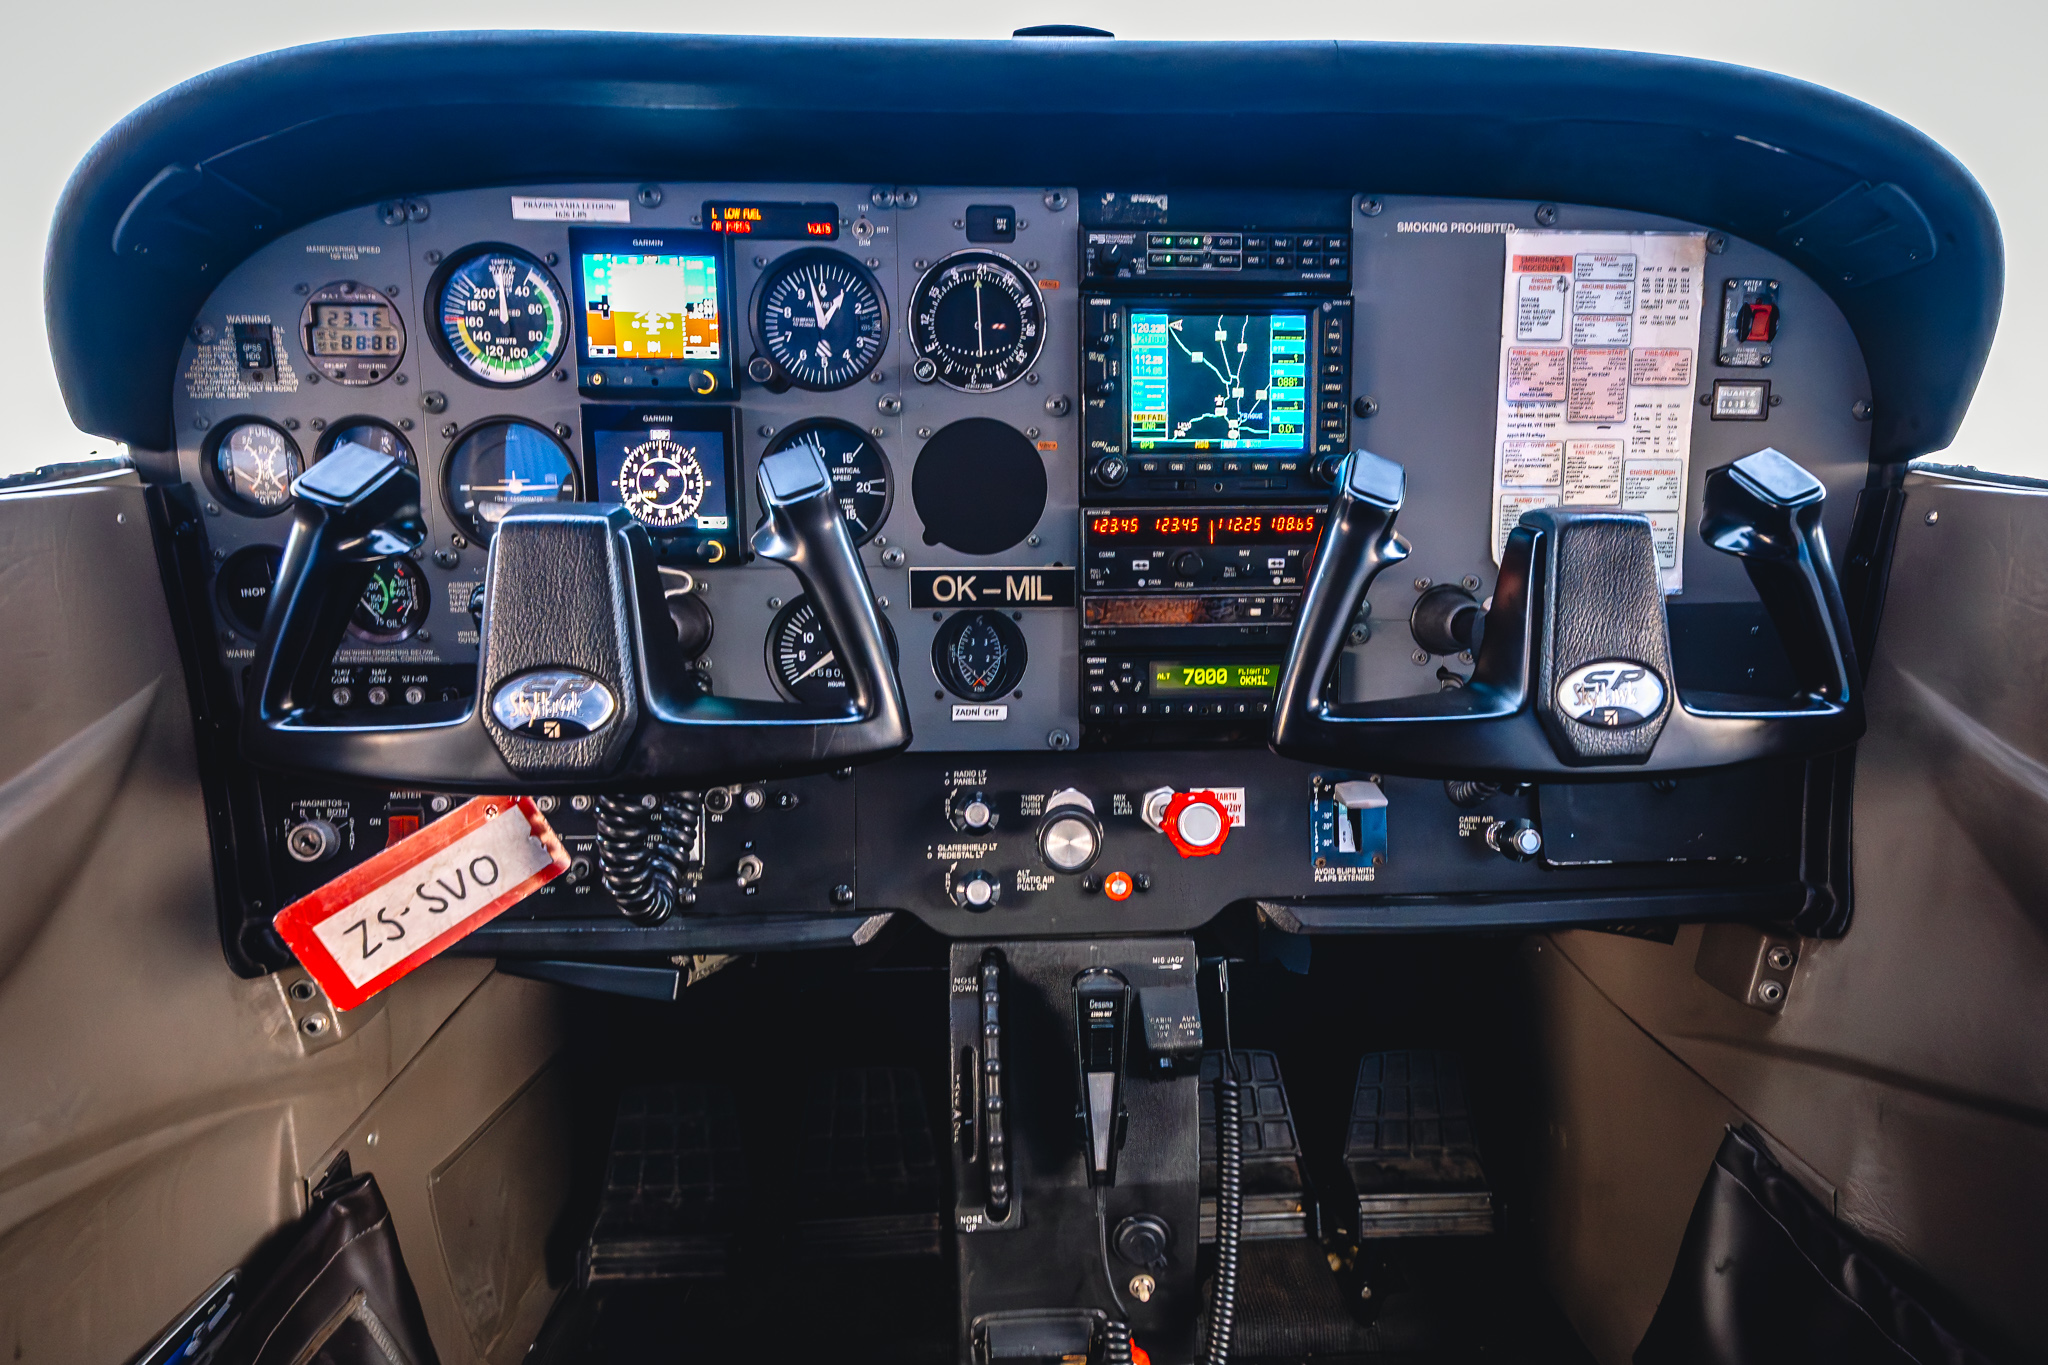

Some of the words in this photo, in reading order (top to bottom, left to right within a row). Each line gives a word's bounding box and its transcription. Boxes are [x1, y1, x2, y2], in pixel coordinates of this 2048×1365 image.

[724, 207, 740, 220] LOW
[743, 208, 761, 220] FUEL
[807, 222, 832, 235] VOLTS
[1397, 222, 1448, 233] SMOKING
[1451, 222, 1516, 234] PROHIBITED
[632, 239, 664, 247] GARMIN
[977, 264, 988, 275] 21
[473, 288, 496, 300] 200
[515, 286, 530, 298] 40
[467, 300, 486, 312] 180
[528, 304, 543, 315] 60
[226, 314, 271, 324] WARNING
[465, 316, 484, 328] 160
[473, 331, 491, 342] 140
[528, 330, 543, 341] 80
[785, 331, 792, 343] 7
[485, 345, 504, 357] 120
[510, 347, 528, 358] 100
[642, 414, 673, 423] GARMIN
[842, 452, 854, 464] 15
[832, 467, 861, 475] VERTICAL
[856, 481, 871, 493] 20
[1093, 517, 1139, 533] 123.45
[1155, 517, 1199, 532] 123.45
[1218, 517, 1261, 531] 112.25
[1239, 549, 1251, 557] NAV
[240, 587, 266, 598] INOP
[386, 619, 401, 628] OIL
[803, 631, 815, 643] 10
[1183, 668, 1228, 686] 7000
[1240, 676, 1268, 685] OKMIL
[955, 705, 980, 717] ZADNÍ
[984, 709, 1000, 717] CHT
[1095, 706, 1100, 714] 0
[1188, 705, 1193, 713] 4
[1262, 704, 1268, 712] 7
[954, 770, 977, 778] RADIO
[978, 769, 987, 778] LT
[953, 777, 978, 786] PANEL
[978, 777, 987, 785] LT
[389, 791, 422, 800] MASTER
[1020, 794, 1046, 802] THROT
[1113, 793, 1127, 801] MIX
[300, 799, 342, 808] MAGNETOS
[1020, 801, 1041, 809] PUSH
[1020, 808, 1041, 816] OPEN
[1113, 807, 1133, 815] LEAN
[650, 813, 662, 821] ON
[711, 814, 723, 823] ON
[1459, 816, 1484, 824] CABIN
[369, 818, 382, 826] ON
[1459, 823, 1477, 831] PULL
[576, 843, 593, 852] NAV
[937, 843, 988, 852] GLARESHIELD
[989, 843, 998, 851] LT
[937, 851, 974, 860] PEDESTAL
[976, 850, 984, 859] LT
[1016, 869, 1031, 877] ALT
[1357, 866, 1375, 874] WITH
[1016, 876, 1041, 884] STATIC
[1042, 875, 1055, 884] AIR
[1314, 874, 1337, 882] FLAPS
[1338, 874, 1375, 882] EXTENDED
[540, 886, 556, 895] OFF
[575, 885, 591, 894] OFF
[1016, 883, 1035, 891] PULL
[1036, 883, 1048, 891] ON
[342, 855, 499, 960] ZS-SVO
[953, 976, 977, 985] NOSE
[952, 984, 979, 993] DOWN
[1089, 999, 1114, 1009] Cessna
[1178, 1022, 1201, 1030] AUDIO
[960, 1214, 983, 1225] NOSE
[966, 1224, 978, 1233] UP
